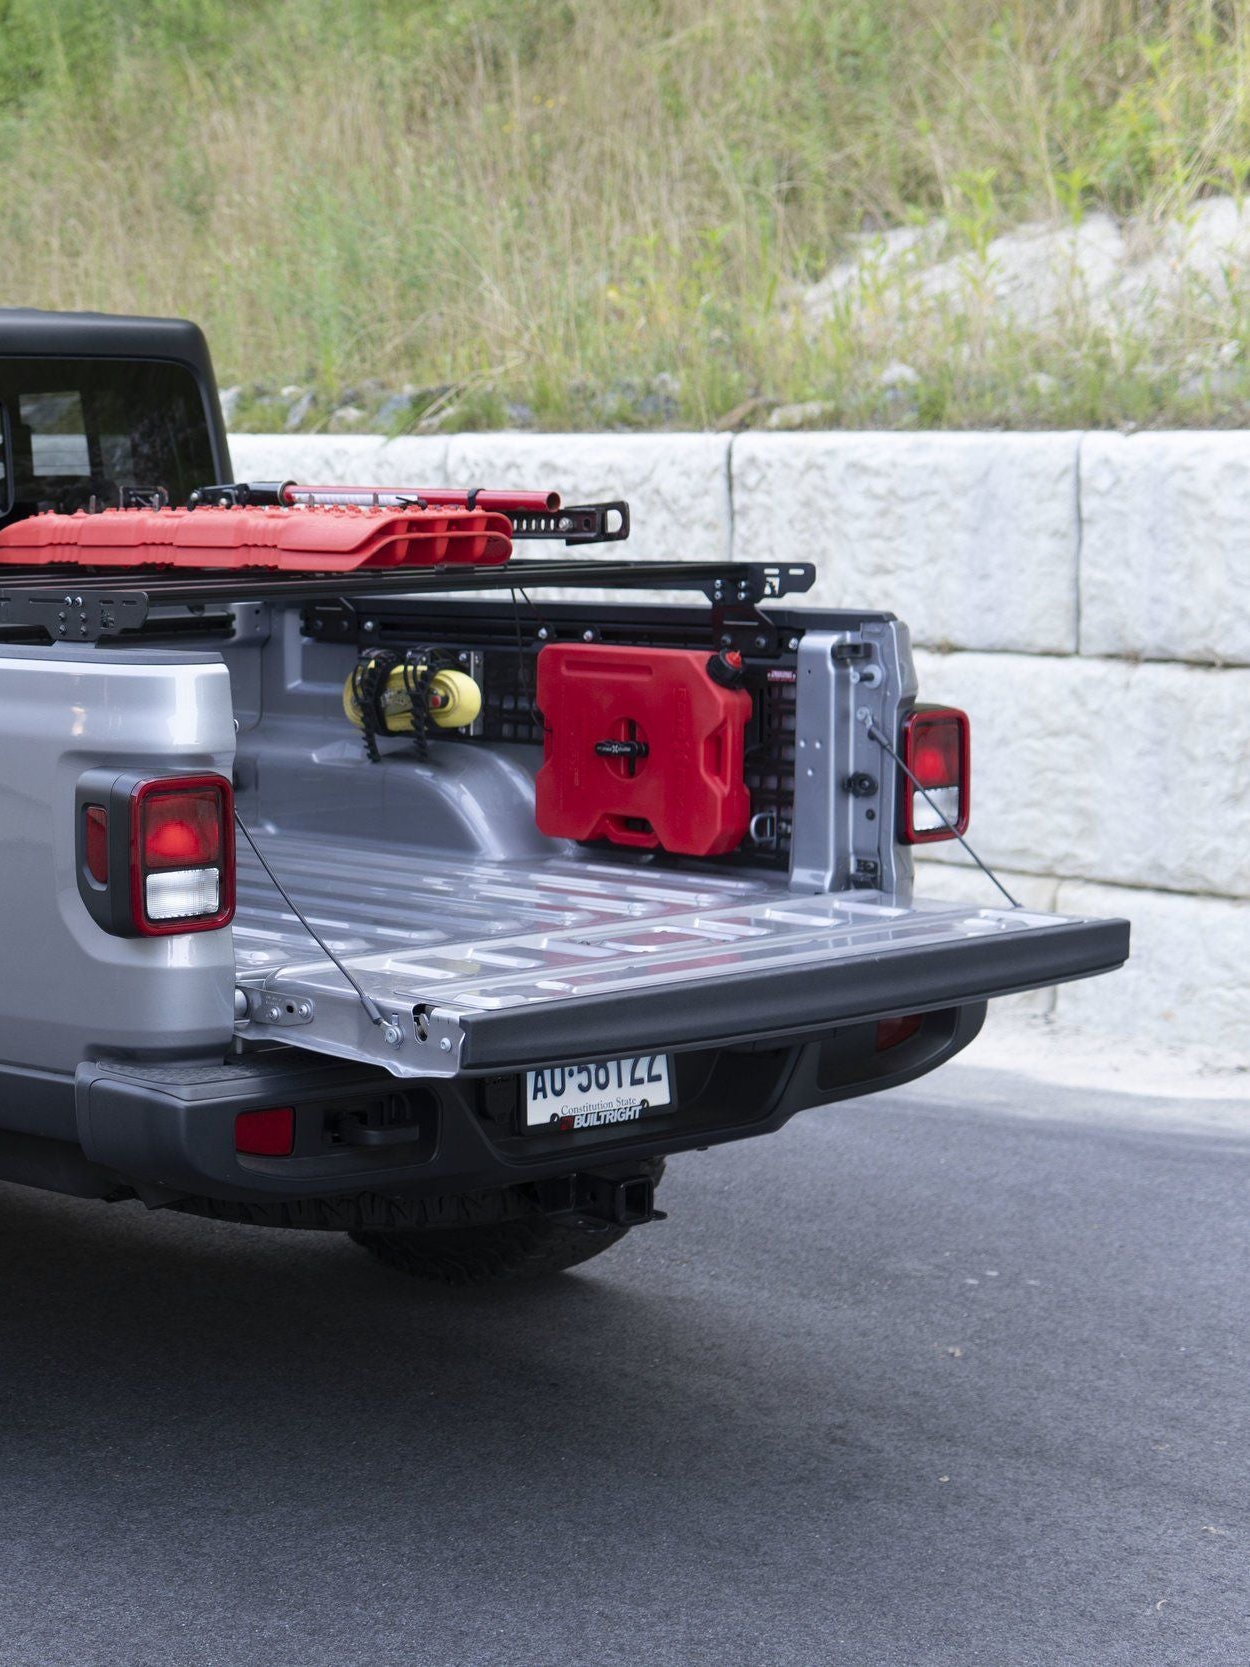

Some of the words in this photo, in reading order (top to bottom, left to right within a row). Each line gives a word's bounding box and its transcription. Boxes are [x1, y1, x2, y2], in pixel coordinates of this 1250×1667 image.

[561, 1101, 614, 1115] Constitution
[615, 1097, 637, 1107] State
[573, 1105, 642, 1129] BUILTRIGHT
